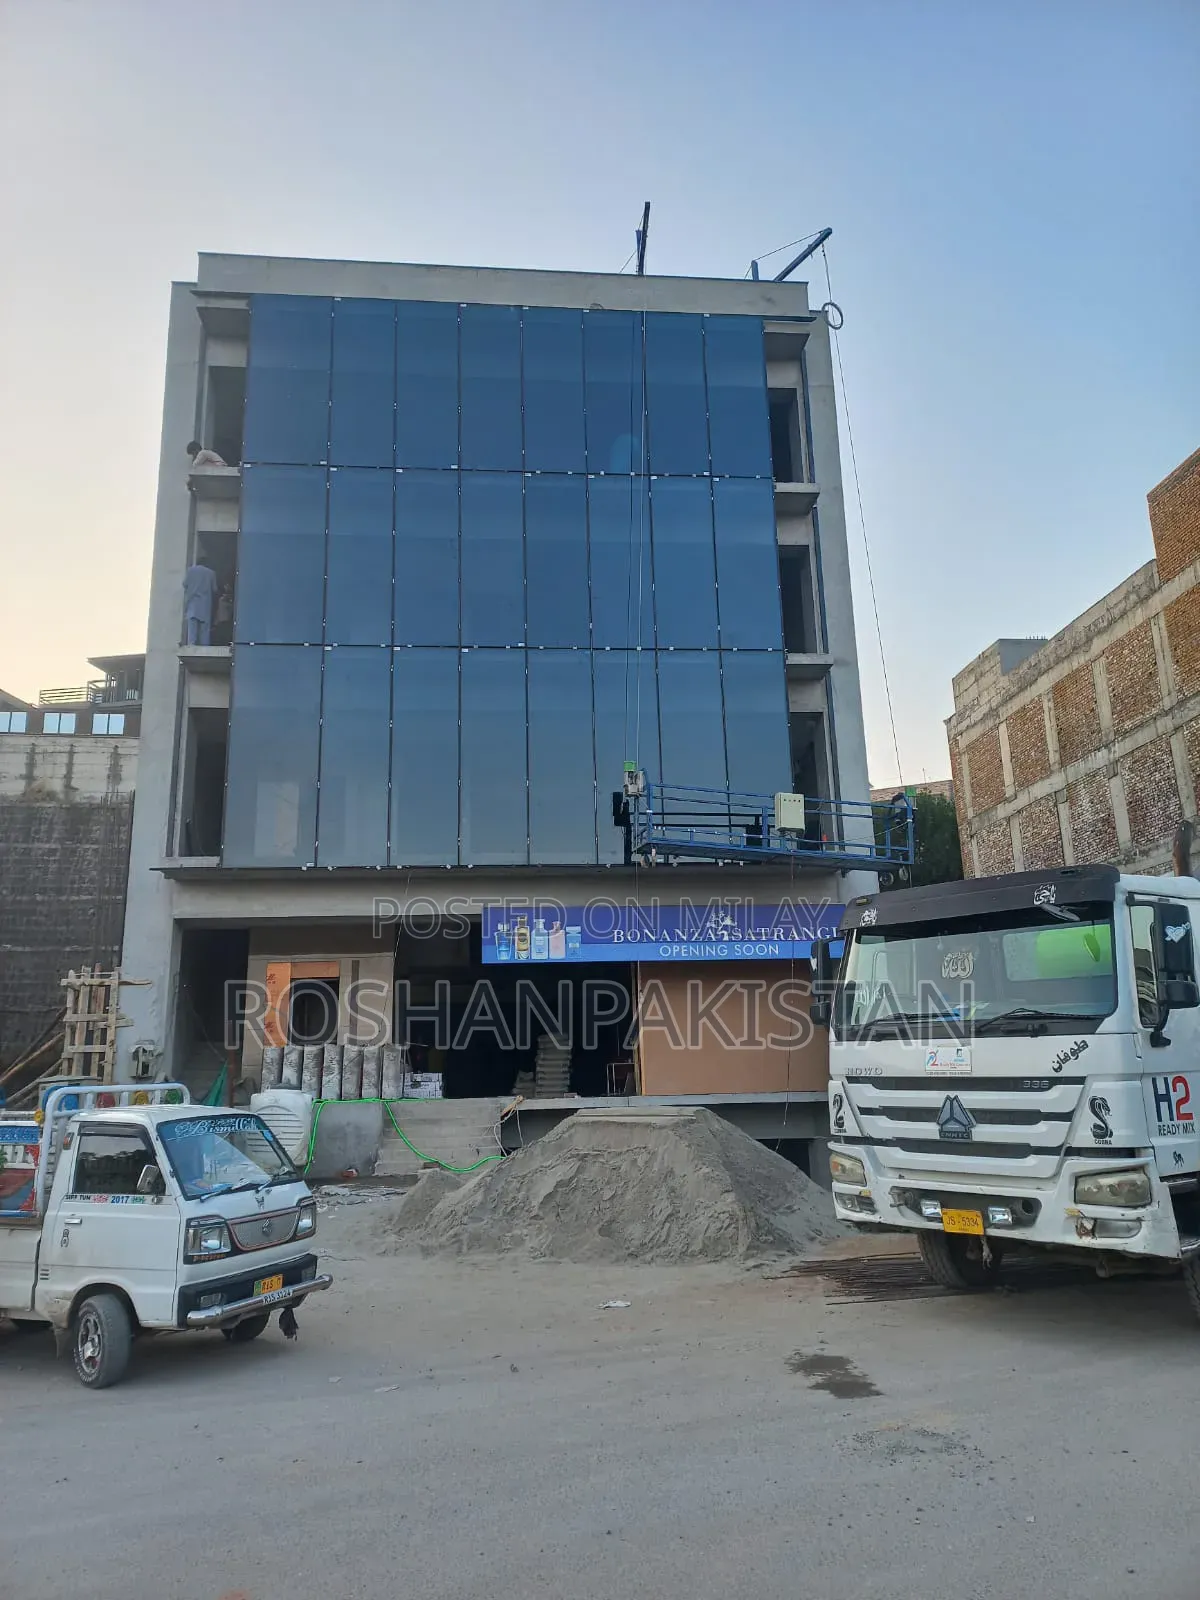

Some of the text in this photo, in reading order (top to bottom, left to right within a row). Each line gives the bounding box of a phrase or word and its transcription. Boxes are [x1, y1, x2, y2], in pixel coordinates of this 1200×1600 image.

[612, 926, 839, 943] BONANZA SATRANGI
[659, 943, 779, 957] OPENING SOON
[1052, 1039, 1089, 1073] طوفان
[1151, 1075, 1194, 1123] H2
[1158, 1122, 1195, 1136] READY MIX
[110, 1195, 130, 1204] 2017
